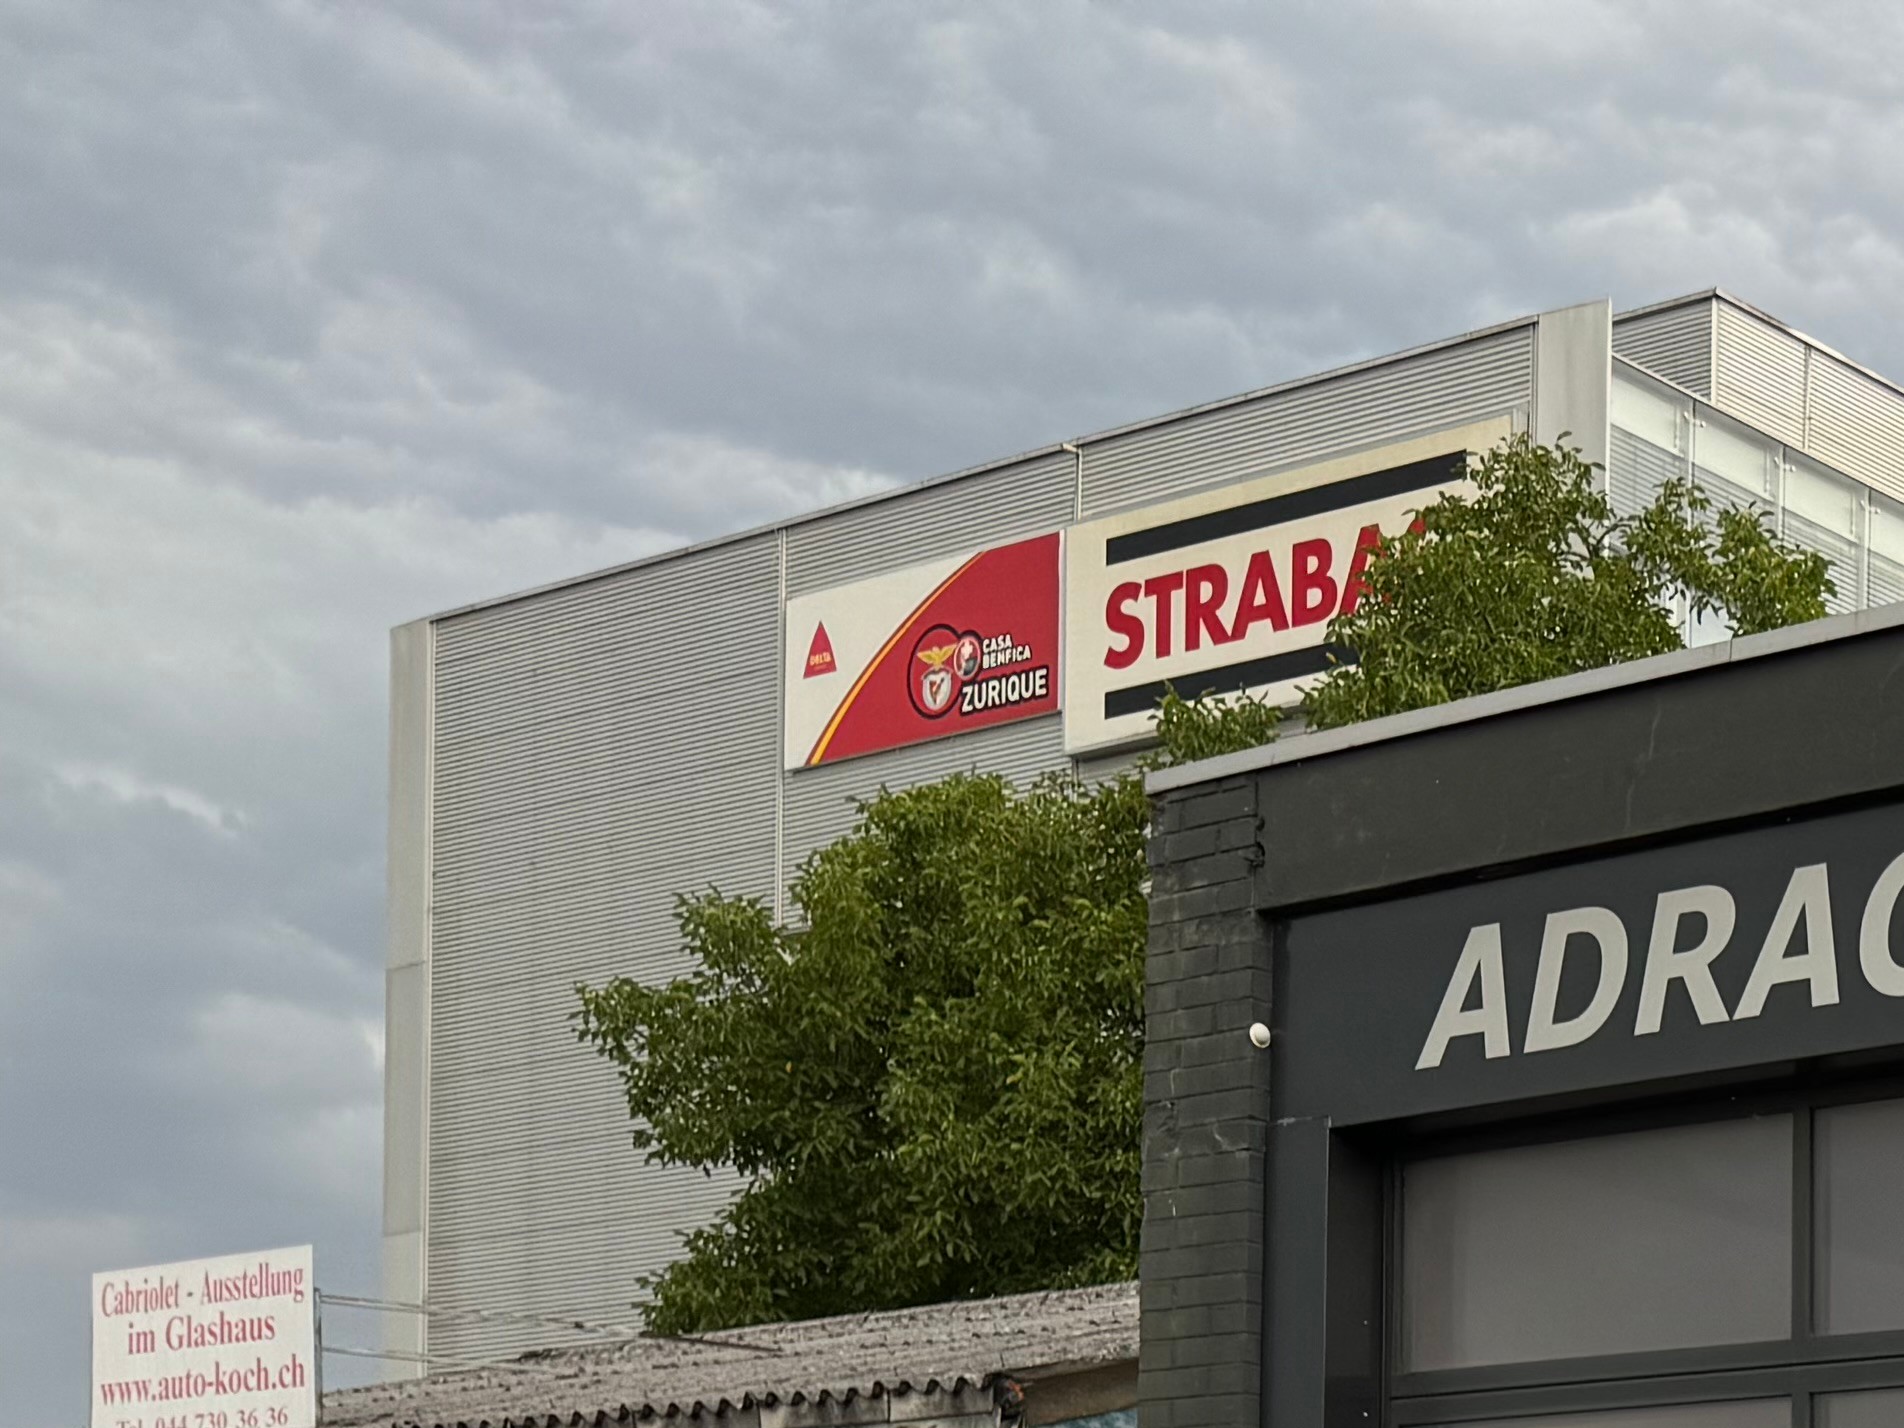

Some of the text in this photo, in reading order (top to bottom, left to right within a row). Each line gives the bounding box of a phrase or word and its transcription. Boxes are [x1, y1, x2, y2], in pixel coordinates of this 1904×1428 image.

[1104, 519, 1426, 669] STRABA
[810, 652, 831, 666] DELTA
[983, 634, 1012, 653] CASA
[983, 645, 1031, 669] BENFICA
[962, 668, 1047, 713] ZURIQUE
[102, 1276, 180, 1317] Cabriolet
[200, 1262, 304, 1305] Ausstellung
[128, 1311, 275, 1355] im Glashaus
[101, 1353, 305, 1406] www.auto-koch.ch
[266, 1406, 288, 1427] 36
